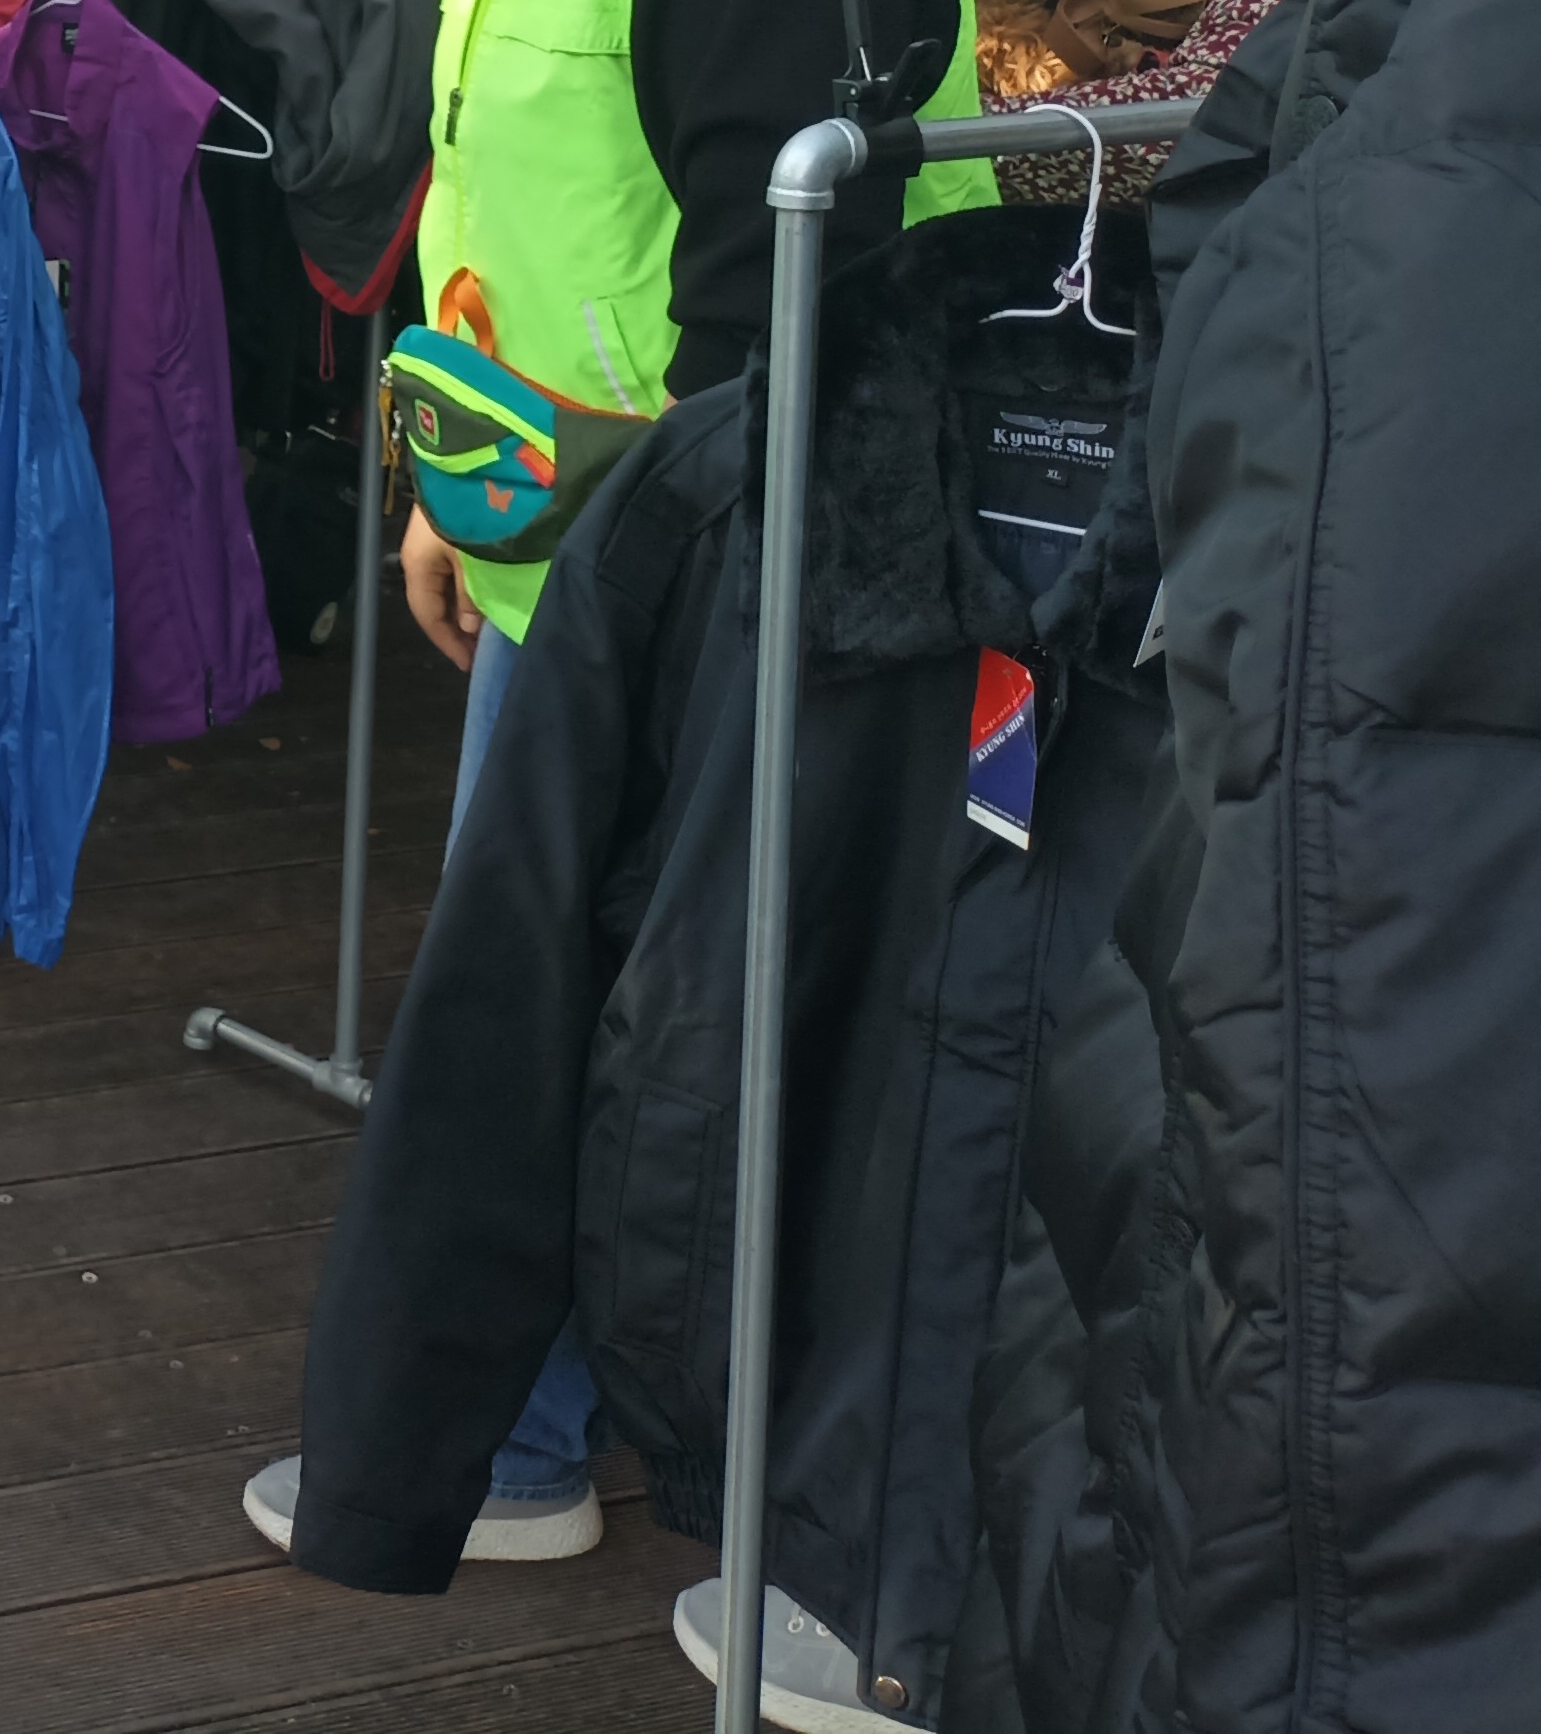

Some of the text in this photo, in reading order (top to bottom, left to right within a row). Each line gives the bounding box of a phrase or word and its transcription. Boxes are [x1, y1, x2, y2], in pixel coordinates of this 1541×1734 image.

[992, 428, 1115, 459] Kyung Shin
[1046, 469, 1062, 481] XL
[975, 711, 1026, 763] KYUNG SHIN
